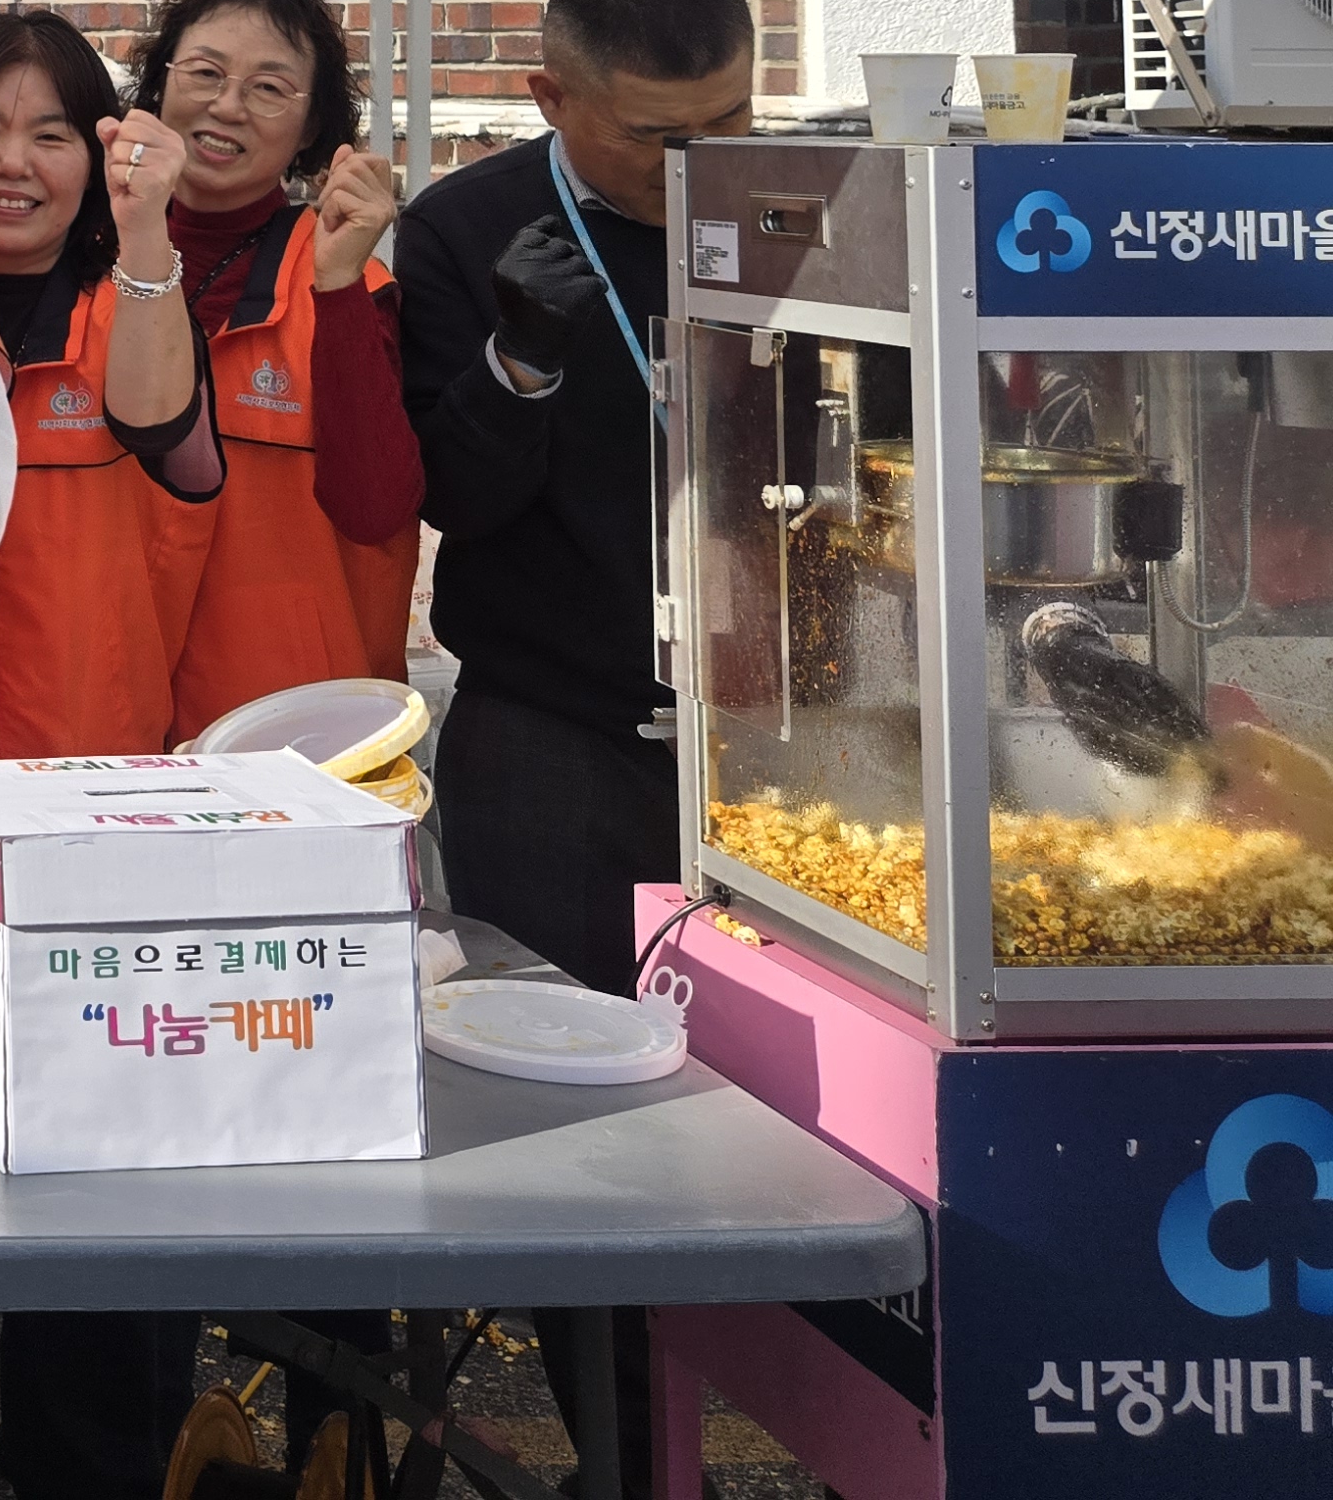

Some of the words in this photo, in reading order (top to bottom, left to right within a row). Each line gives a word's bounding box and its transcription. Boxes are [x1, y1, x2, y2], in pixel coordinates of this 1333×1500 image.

[48, 944, 205, 980] 마음으로
[213, 936, 368, 974] 결제하는
[82, 993, 335, 1058] “나눔카페”
[1027, 1356, 1333, 1437] 신정새마
